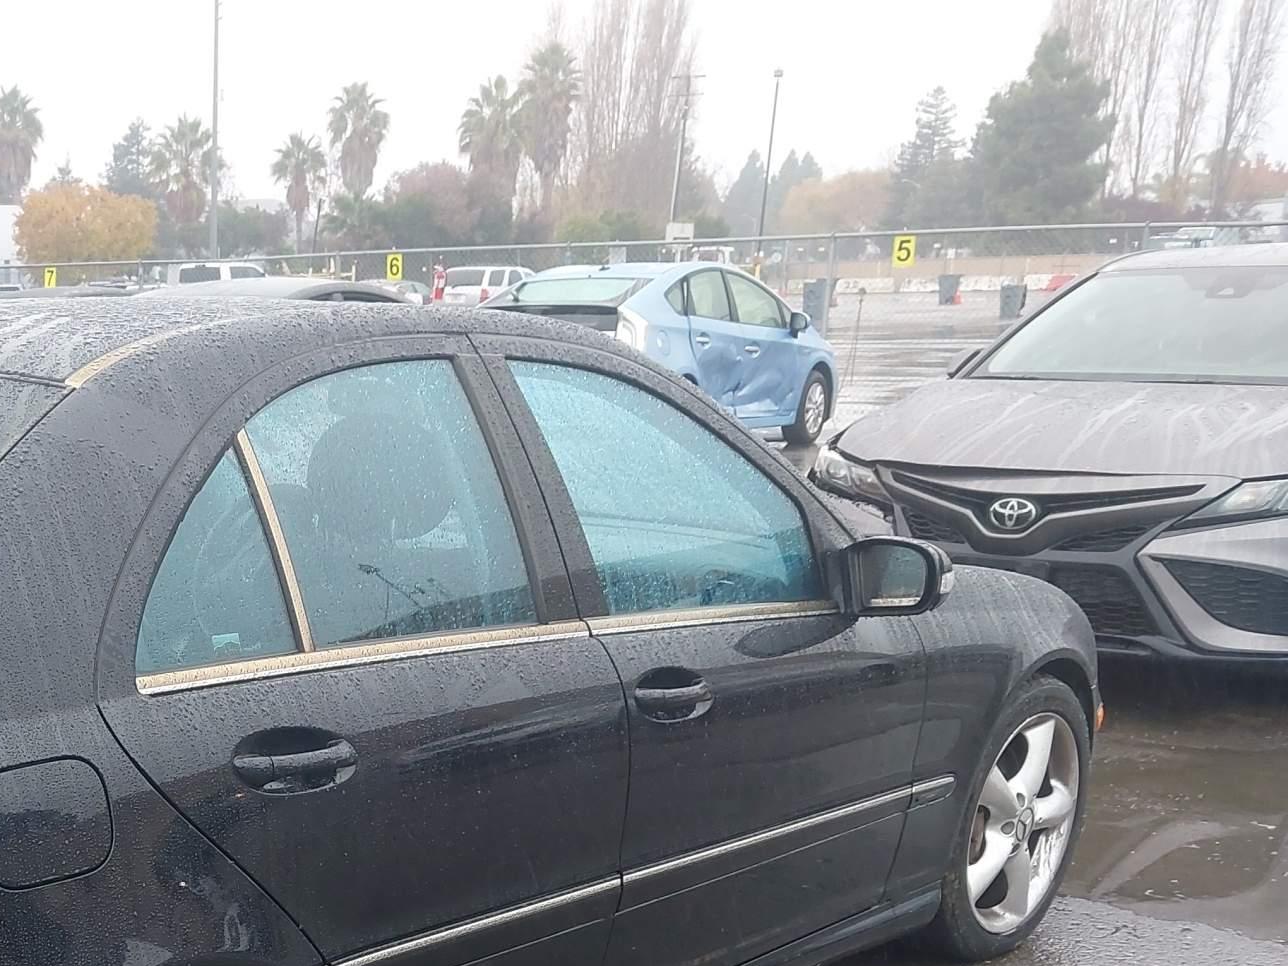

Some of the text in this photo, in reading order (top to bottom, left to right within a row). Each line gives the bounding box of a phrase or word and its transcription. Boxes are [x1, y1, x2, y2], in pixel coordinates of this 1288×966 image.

[896, 240, 911, 262] 5
[390, 256, 400, 276] 6
[47, 270, 54, 287] 7
